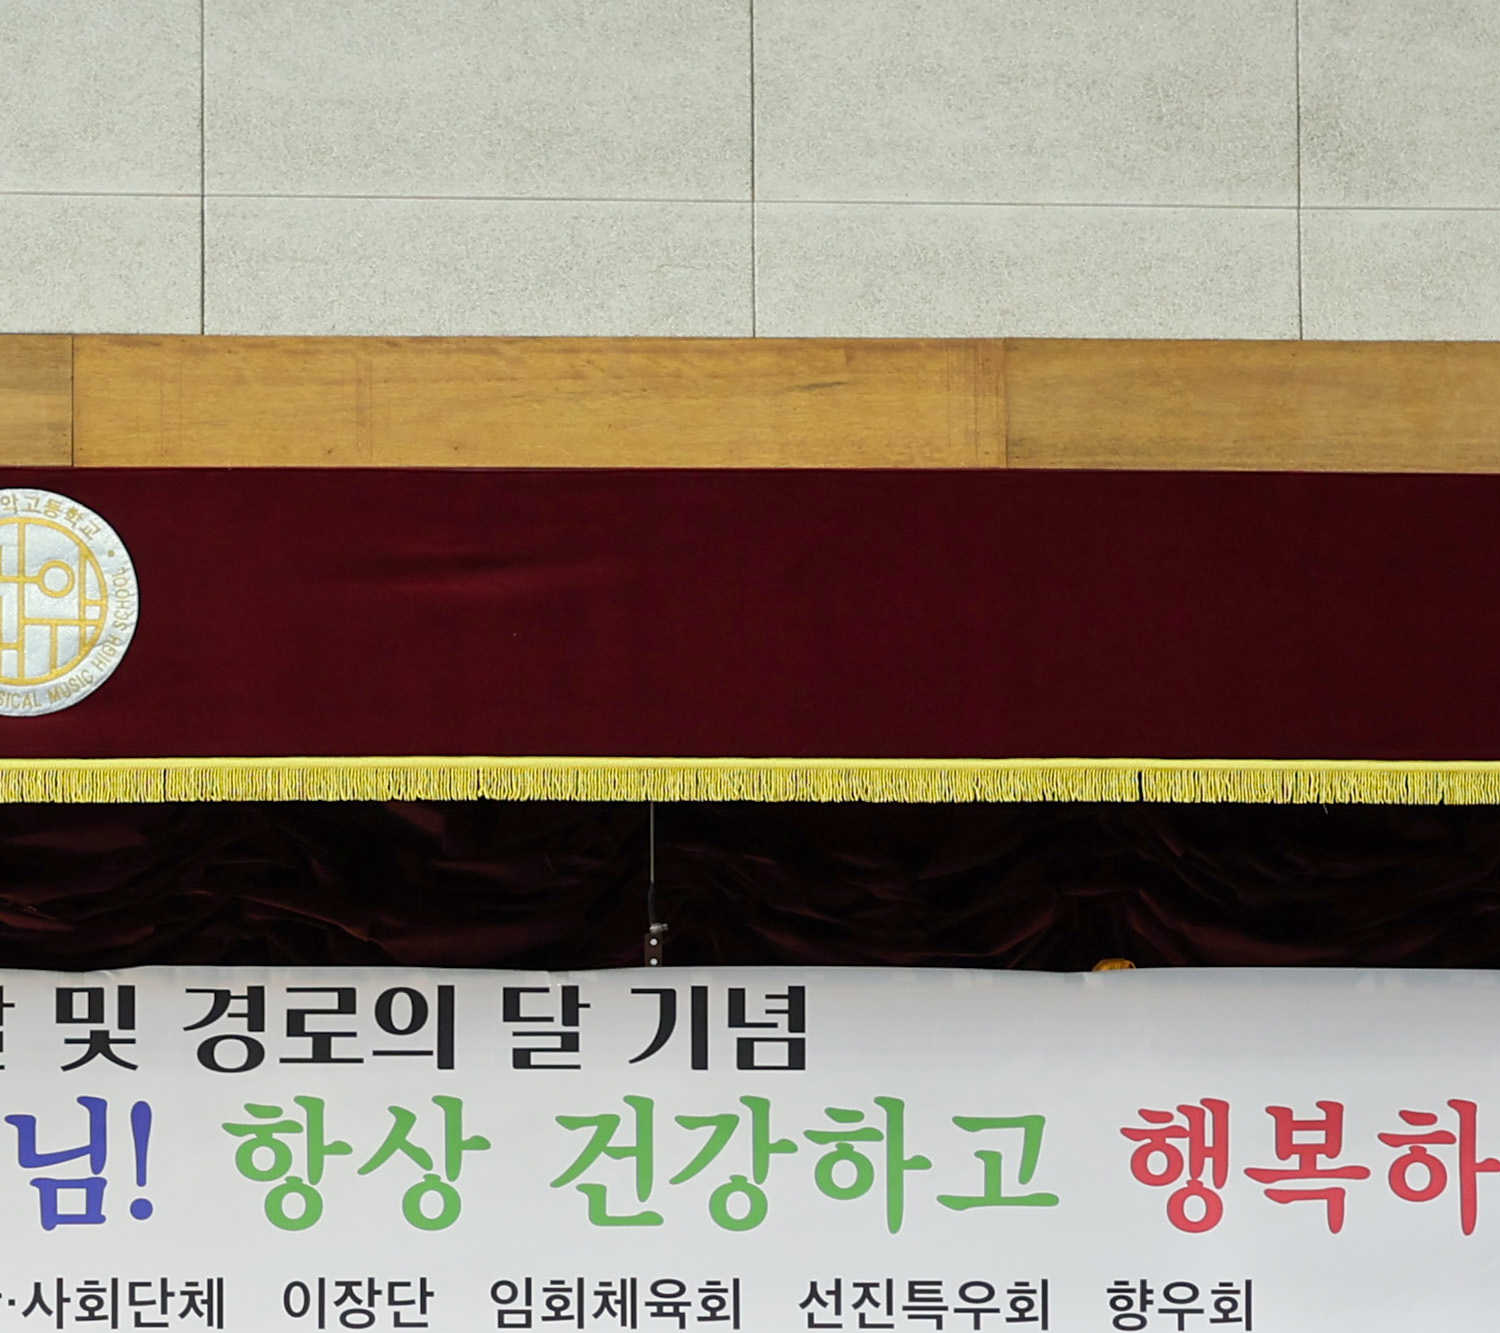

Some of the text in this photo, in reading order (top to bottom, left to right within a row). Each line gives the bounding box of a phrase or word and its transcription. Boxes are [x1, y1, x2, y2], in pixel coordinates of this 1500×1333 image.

[46, 669, 94, 703] MUSIC
[91, 634, 123, 678] HIGH
[111, 566, 133, 632] SCHOOL
[56, 985, 139, 1073] 및
[184, 985, 456, 1075] 경로의
[503, 985, 592, 1071] 달
[630, 986, 807, 1073] 기념
[226, 1096, 490, 1232] 항상
[555, 1097, 1059, 1232] 건강하고
[283, 1277, 436, 1331] 이장단
[490, 1277, 743, 1332] 임회체육회
[798, 1278, 1051, 1332] 선진특우회
[1106, 1278, 1255, 1333] 향우회
